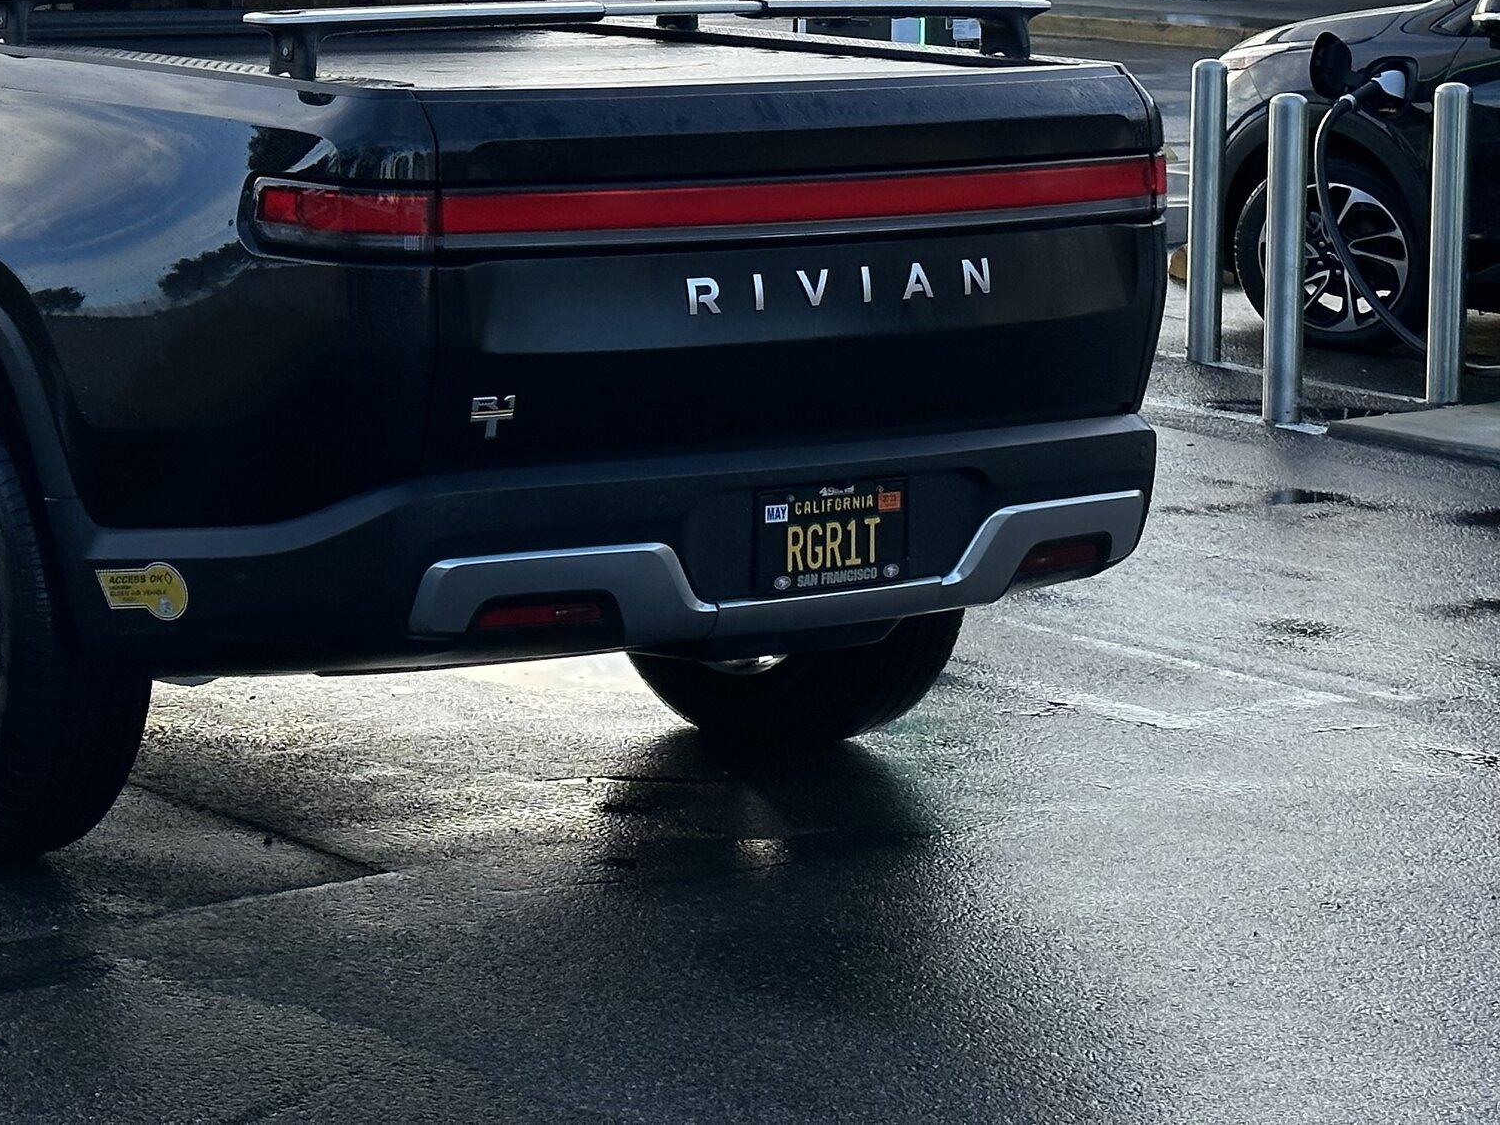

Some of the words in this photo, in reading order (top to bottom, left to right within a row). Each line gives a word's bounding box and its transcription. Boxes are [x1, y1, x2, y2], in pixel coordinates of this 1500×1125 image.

[686, 257, 991, 315] RIVIAN
[766, 506, 787, 522] MAY
[794, 494, 874, 516] CALIFORNIA
[787, 517, 881, 573] RGR1T
[109, 575, 147, 585] ACCESS
[149, 574, 163, 583] OK
[797, 574, 818, 588] SAN
[821, 567, 878, 585] FRANCISCO
